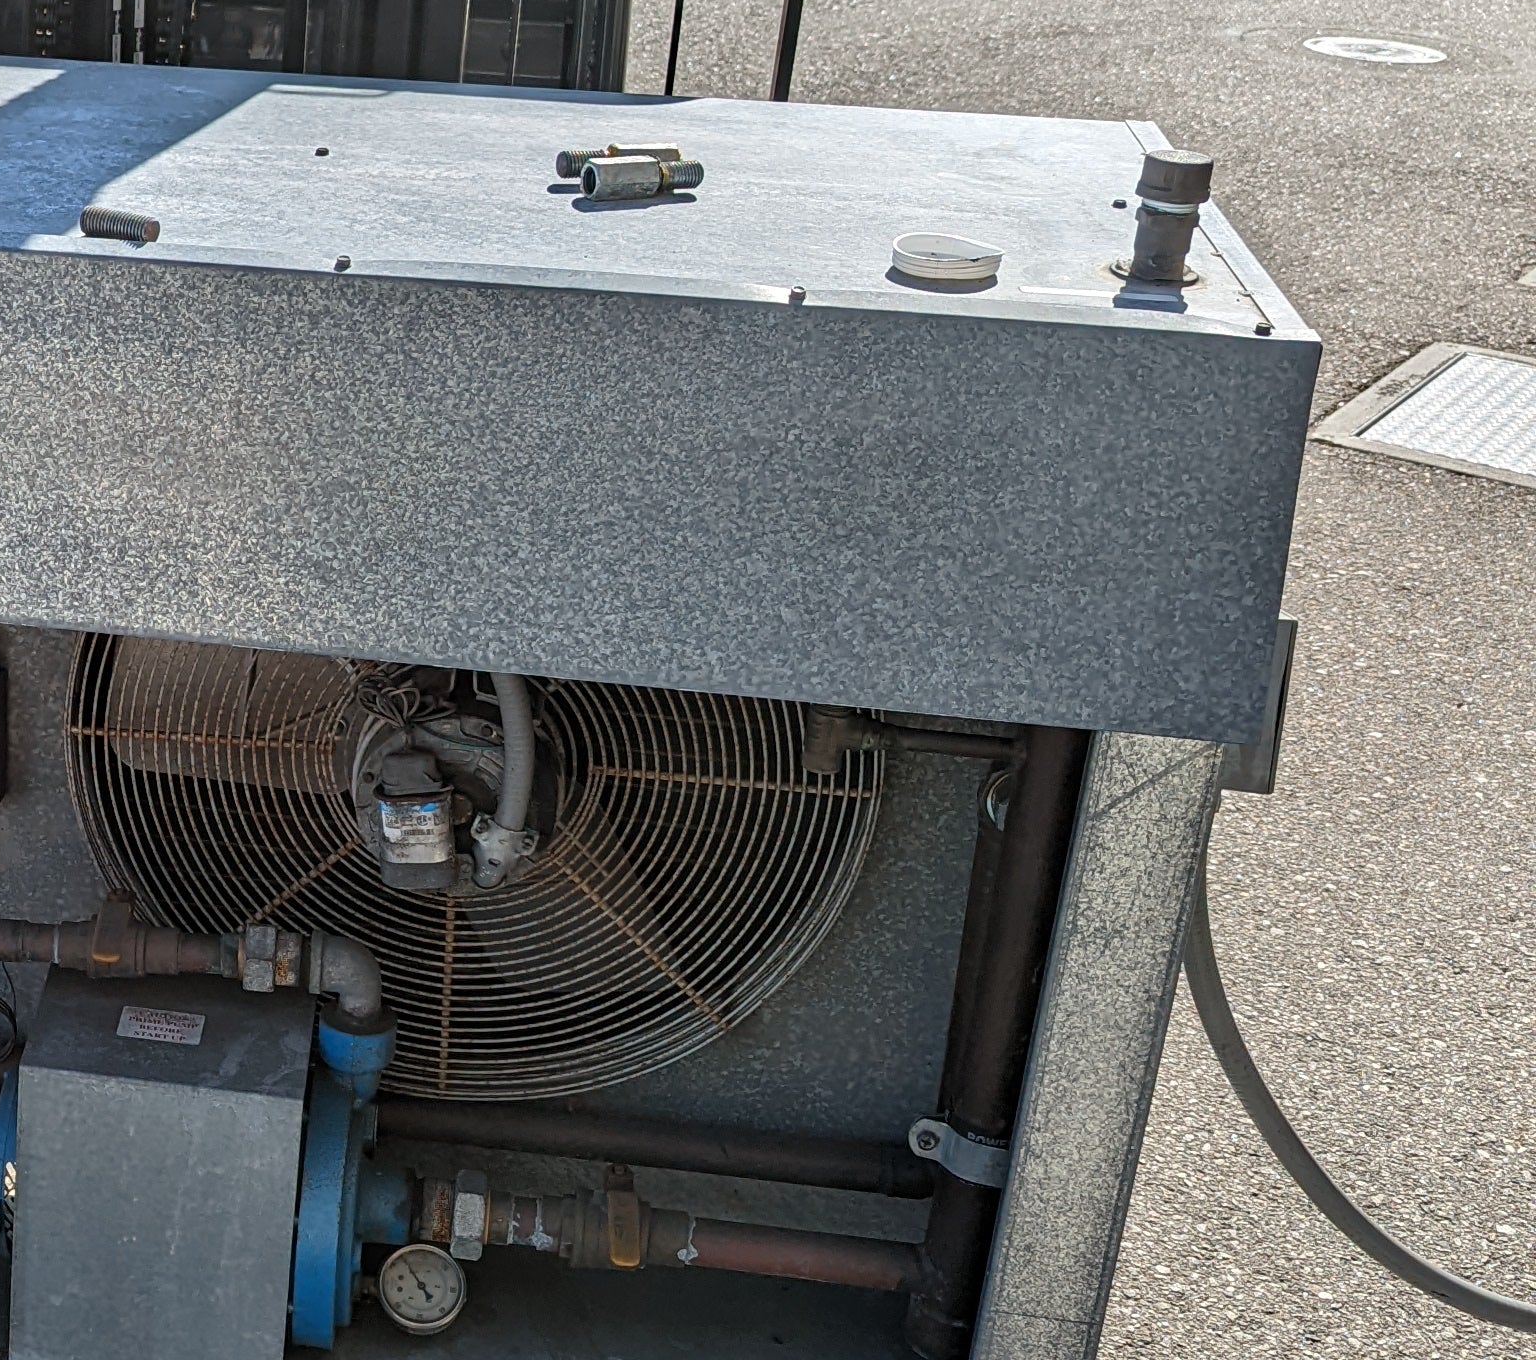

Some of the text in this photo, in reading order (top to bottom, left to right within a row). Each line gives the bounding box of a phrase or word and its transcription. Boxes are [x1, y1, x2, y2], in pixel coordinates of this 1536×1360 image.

[139, 1024, 183, 1034] BEFORE
[133, 1030, 168, 1039] START
[967, 1131, 1008, 1146] POWE
